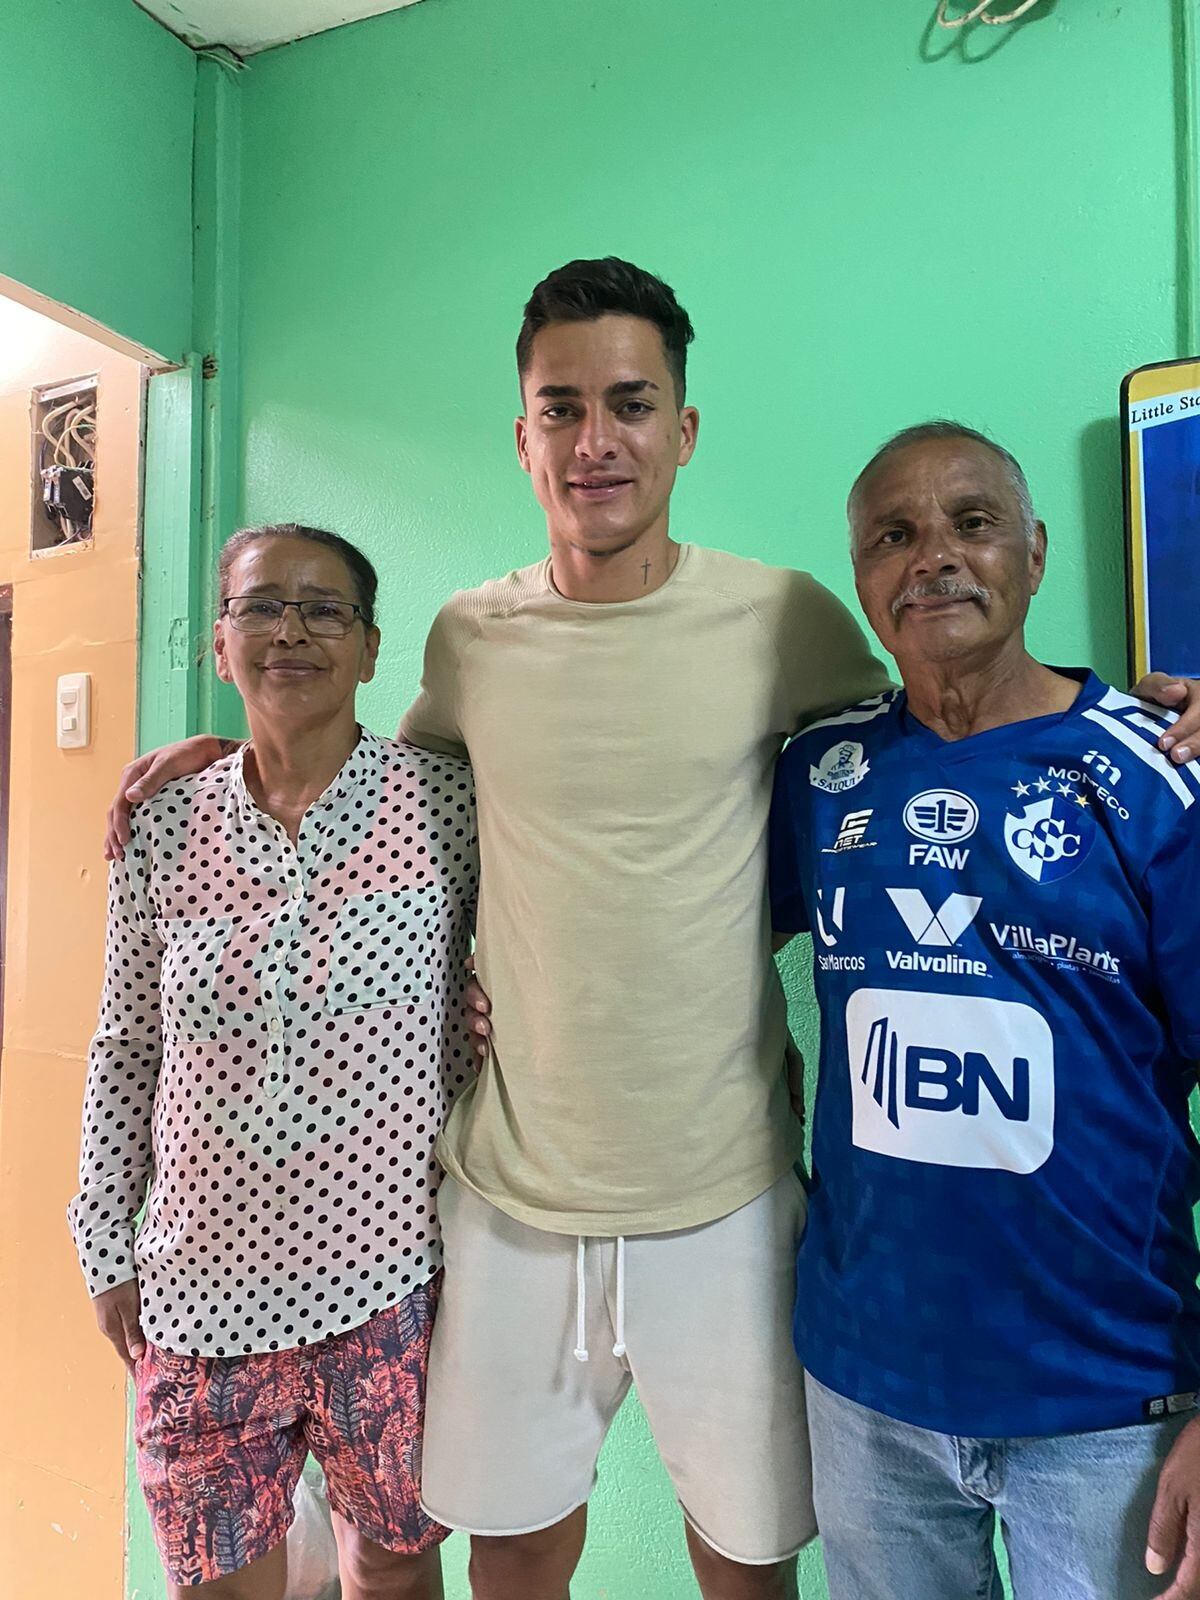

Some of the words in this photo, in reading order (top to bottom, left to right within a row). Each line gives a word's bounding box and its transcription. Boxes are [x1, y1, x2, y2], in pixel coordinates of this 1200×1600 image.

[1131, 403, 1174, 424] Little
[909, 844, 970, 870] FAW
[885, 951, 988, 976] Valvoline
[905, 1045, 1030, 1122] BN
